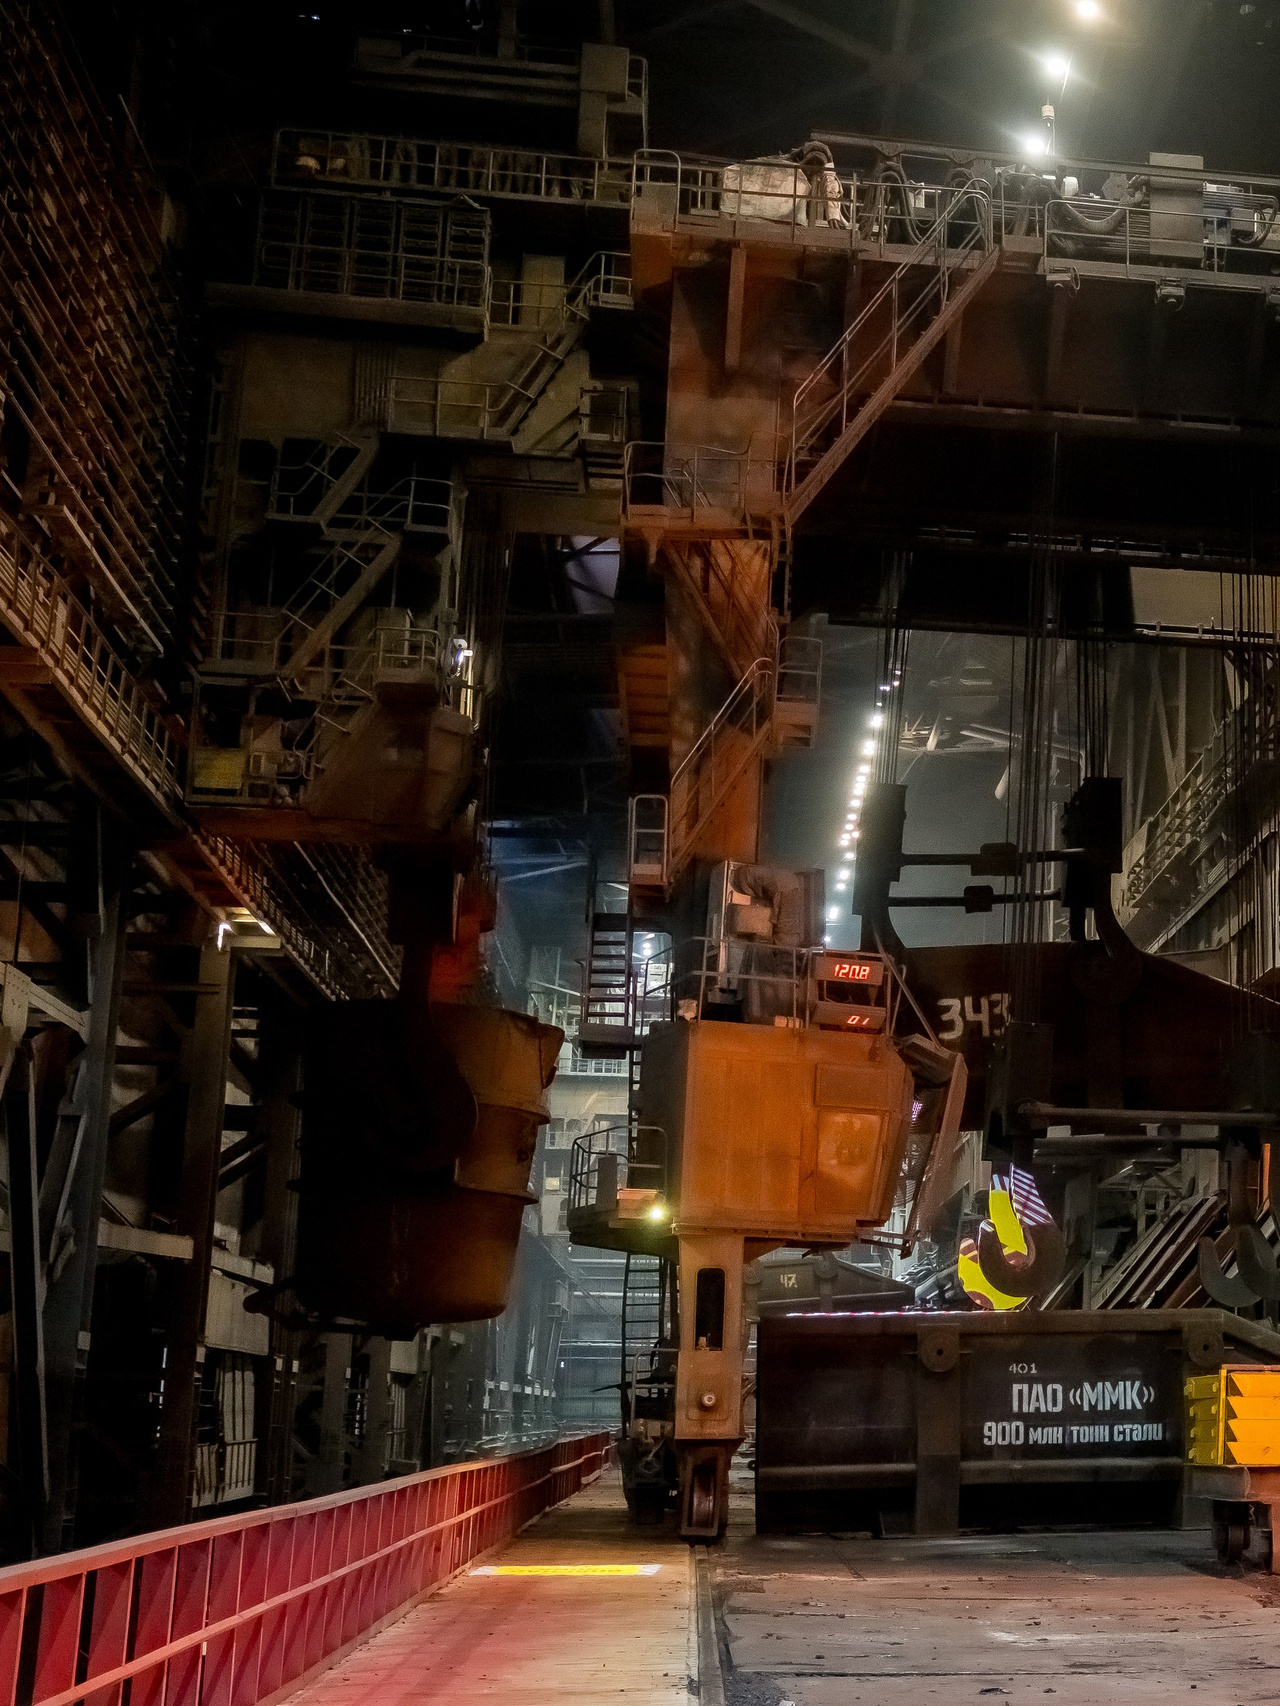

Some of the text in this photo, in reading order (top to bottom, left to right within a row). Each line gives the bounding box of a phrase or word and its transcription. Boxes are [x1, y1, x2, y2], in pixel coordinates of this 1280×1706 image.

[937, 993, 1011, 1040] 343
[1008, 1363, 1038, 1374] 401
[1012, 1381, 1155, 1413] ПАО «ММК»
[983, 1421, 1025, 1446] 900
[1113, 1423, 1163, 1442] стали
